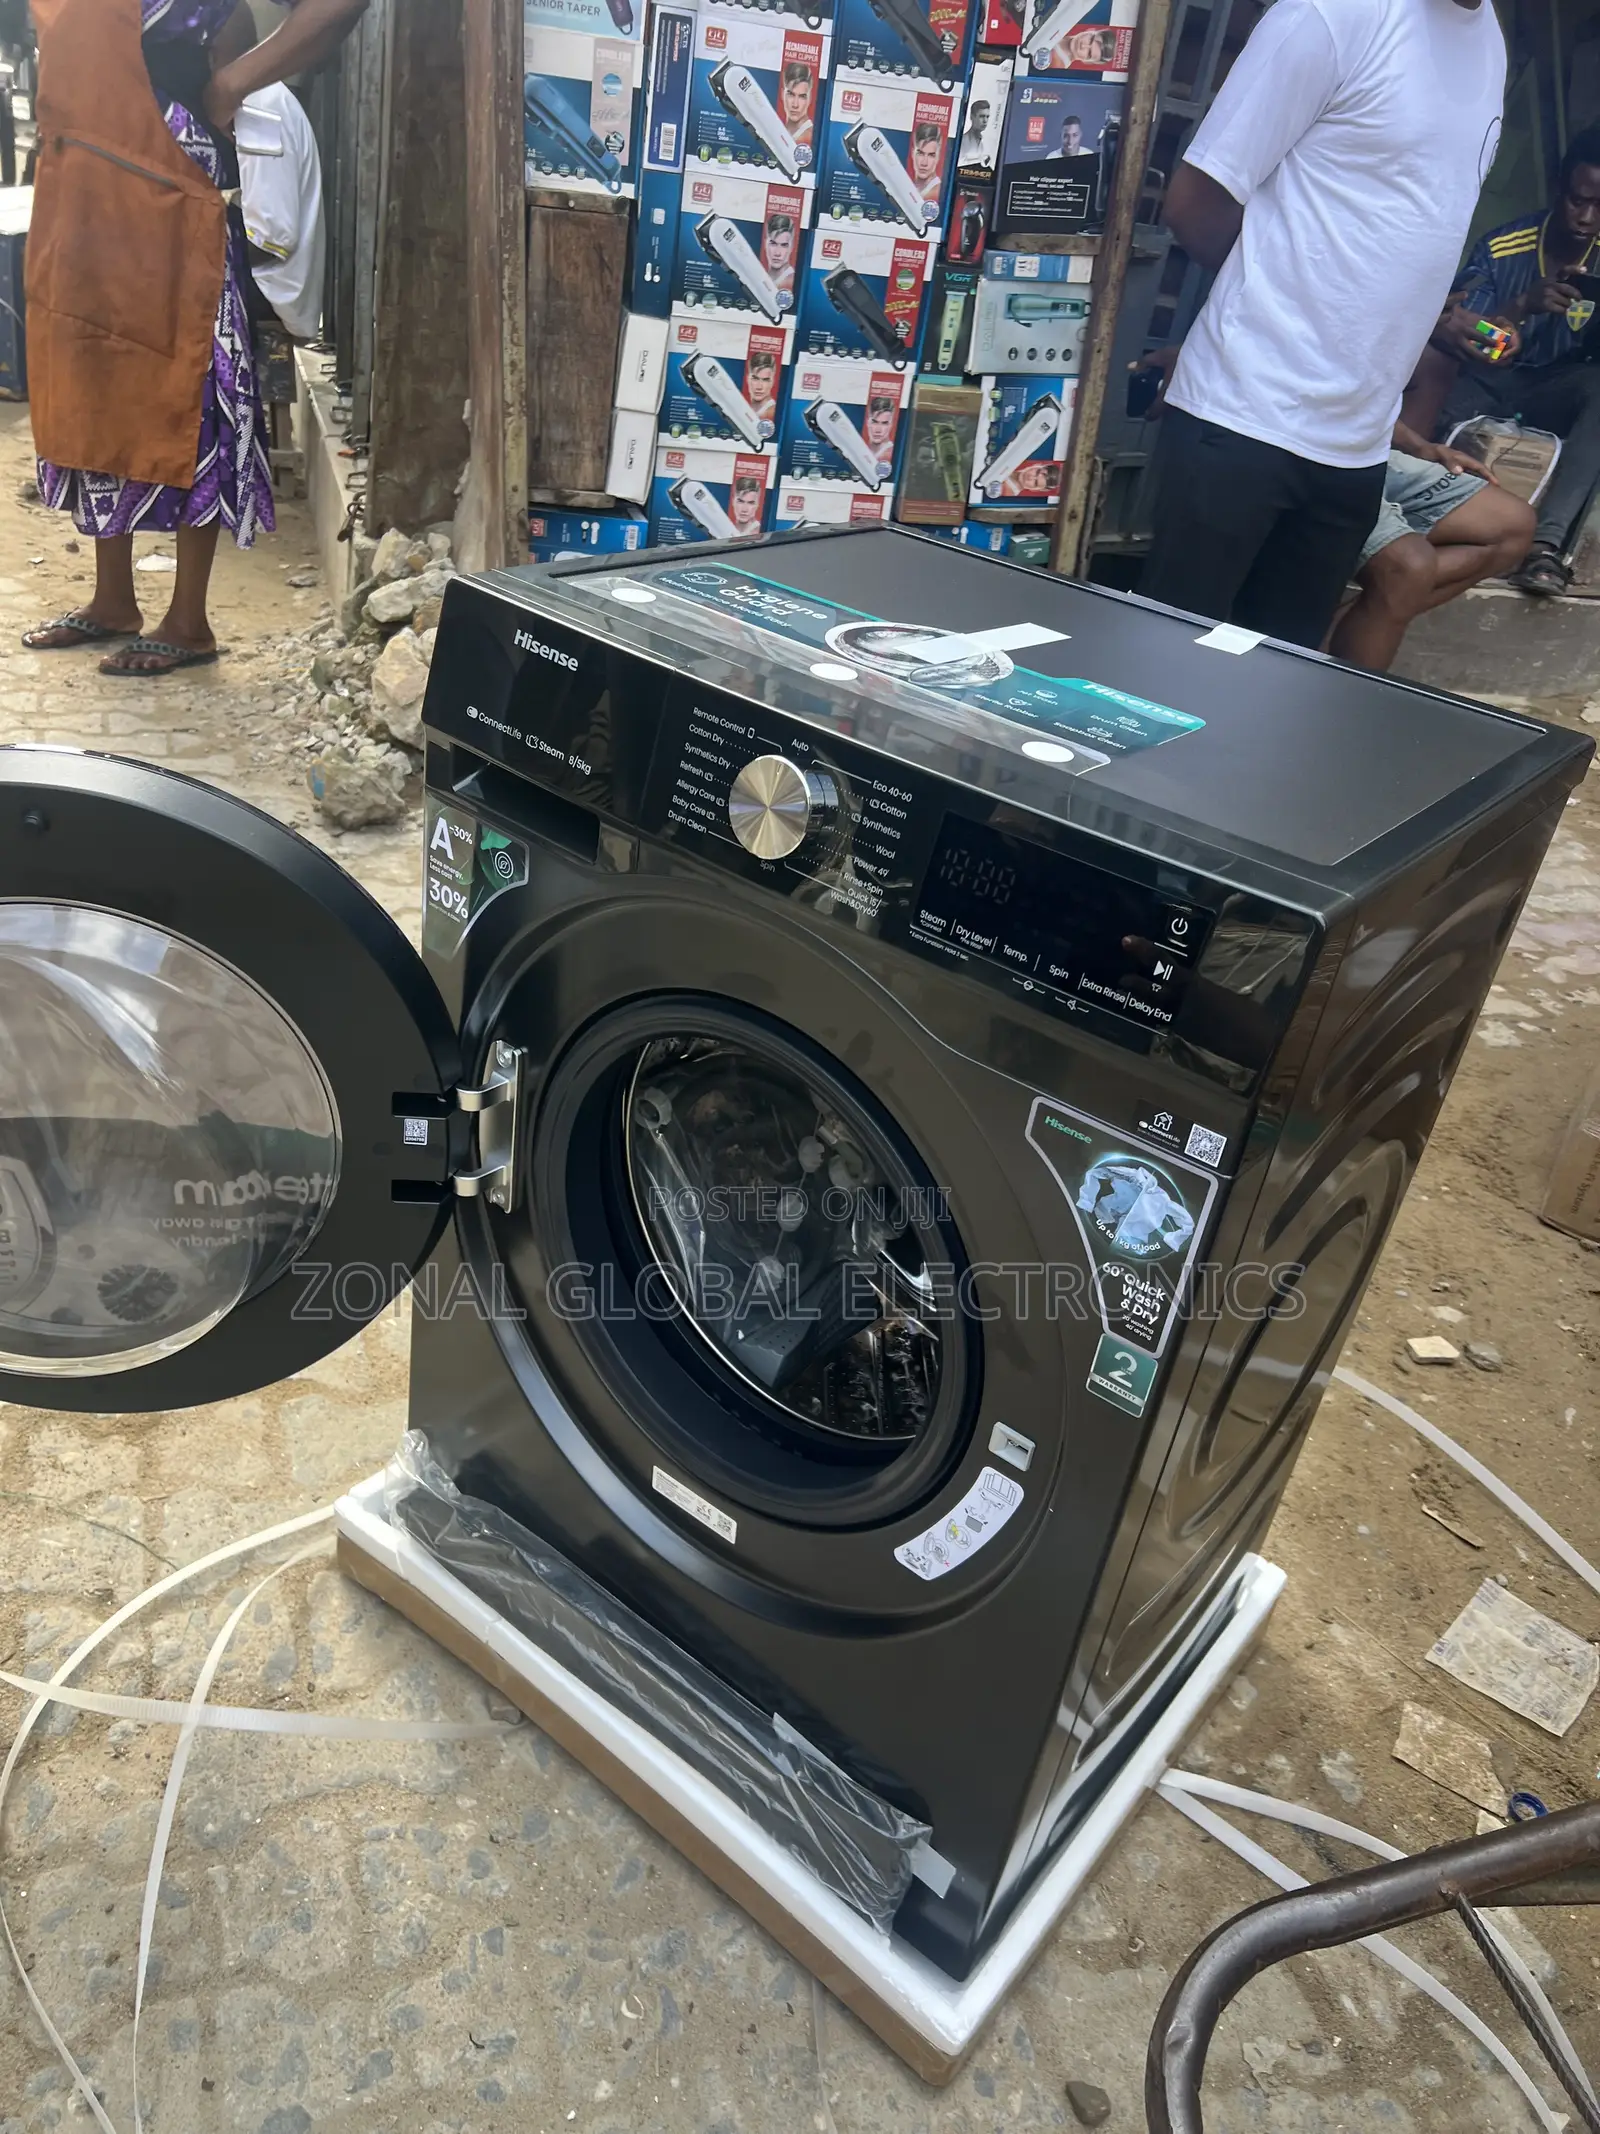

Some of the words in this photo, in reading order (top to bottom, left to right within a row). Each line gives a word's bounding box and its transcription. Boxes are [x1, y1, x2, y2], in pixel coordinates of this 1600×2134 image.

[568, 3, 601, 16] TAPER
[959, 168, 992, 178] TRIMMER
[658, 577, 731, 605] Maintenance
[731, 603, 764, 617] Made
[764, 614, 792, 628] Easy
[719, 588, 793, 617] Guard
[735, 585, 828, 620] Hygiene
[514, 628, 579, 672] Hisense
[1004, 704, 1039, 719] Rubber
[1083, 684, 1196, 725] Hisense
[693, 706, 719, 724] Remote
[719, 718, 746, 735] Control
[1090, 714, 1116, 728] Drum
[1116, 722, 1148, 737] Clean
[479, 712, 522, 740] ConnectLife
[539, 740, 565, 761] Steam
[568, 755, 592, 775] 8/5kg
[688, 724, 712, 740] Cotton
[712, 733, 724, 746] Dry
[791, 738, 809, 752] Auto
[1053, 721, 1098, 741] Soapbox
[1097, 736, 1127, 750] Clean
[684, 742, 718, 765] Synthetics
[718, 757, 731, 770] Dry
[679, 760, 703, 778] Refresh
[676, 778, 699, 796] Allergy
[699, 788, 715, 801] Care
[872, 780, 888, 793] Eco
[888, 786, 913, 803] 40-60
[672, 795, 690, 810] Baby
[689, 803, 706, 816] Care
[880, 802, 907, 820] Cotton
[668, 810, 687, 825] Drum
[687, 818, 707, 834] Clean
[861, 816, 901, 840] Synthetics
[430, 816, 454, 861] A
[429, 854, 442, 867] Save
[875, 844, 896, 860] Wool
[760, 860, 776, 873] Spin
[853, 856, 878, 873] Power
[843, 872, 884, 896] Rinse+Spin
[847, 888, 869, 903] Quick
[429, 876, 469, 919] 30%
[920, 909, 947, 928] Steam
[955, 925, 971, 939] Dry
[971, 931, 993, 947] Level
[1003, 944, 1028, 963] Temp.
[1048, 964, 1069, 980] Spin
[1081, 978, 1103, 993] Extra
[1102, 987, 1126, 1003] Rinse
[1128, 998, 1154, 1016] Delay
[1153, 1008, 1173, 1022] End
[1045, 1115, 1093, 1144] Hisense
[1096, 1218, 1106, 1232] Up
[1105, 1229, 1115, 1239] to
[1119, 1238, 1130, 1250] kg
[1140, 1242, 1161, 1252] load
[1122, 1283, 1161, 1313] Wash
[1124, 1273, 1166, 1301] Quick
[1120, 1298, 1130, 1311] &
[1132, 1303, 1158, 1325] Dry
[1130, 1319, 1154, 1335] washing
[1133, 1327, 1152, 1341] drying
[1108, 1351, 1138, 1388] 2
[1098, 1377, 1136, 1401] WARRANTY
